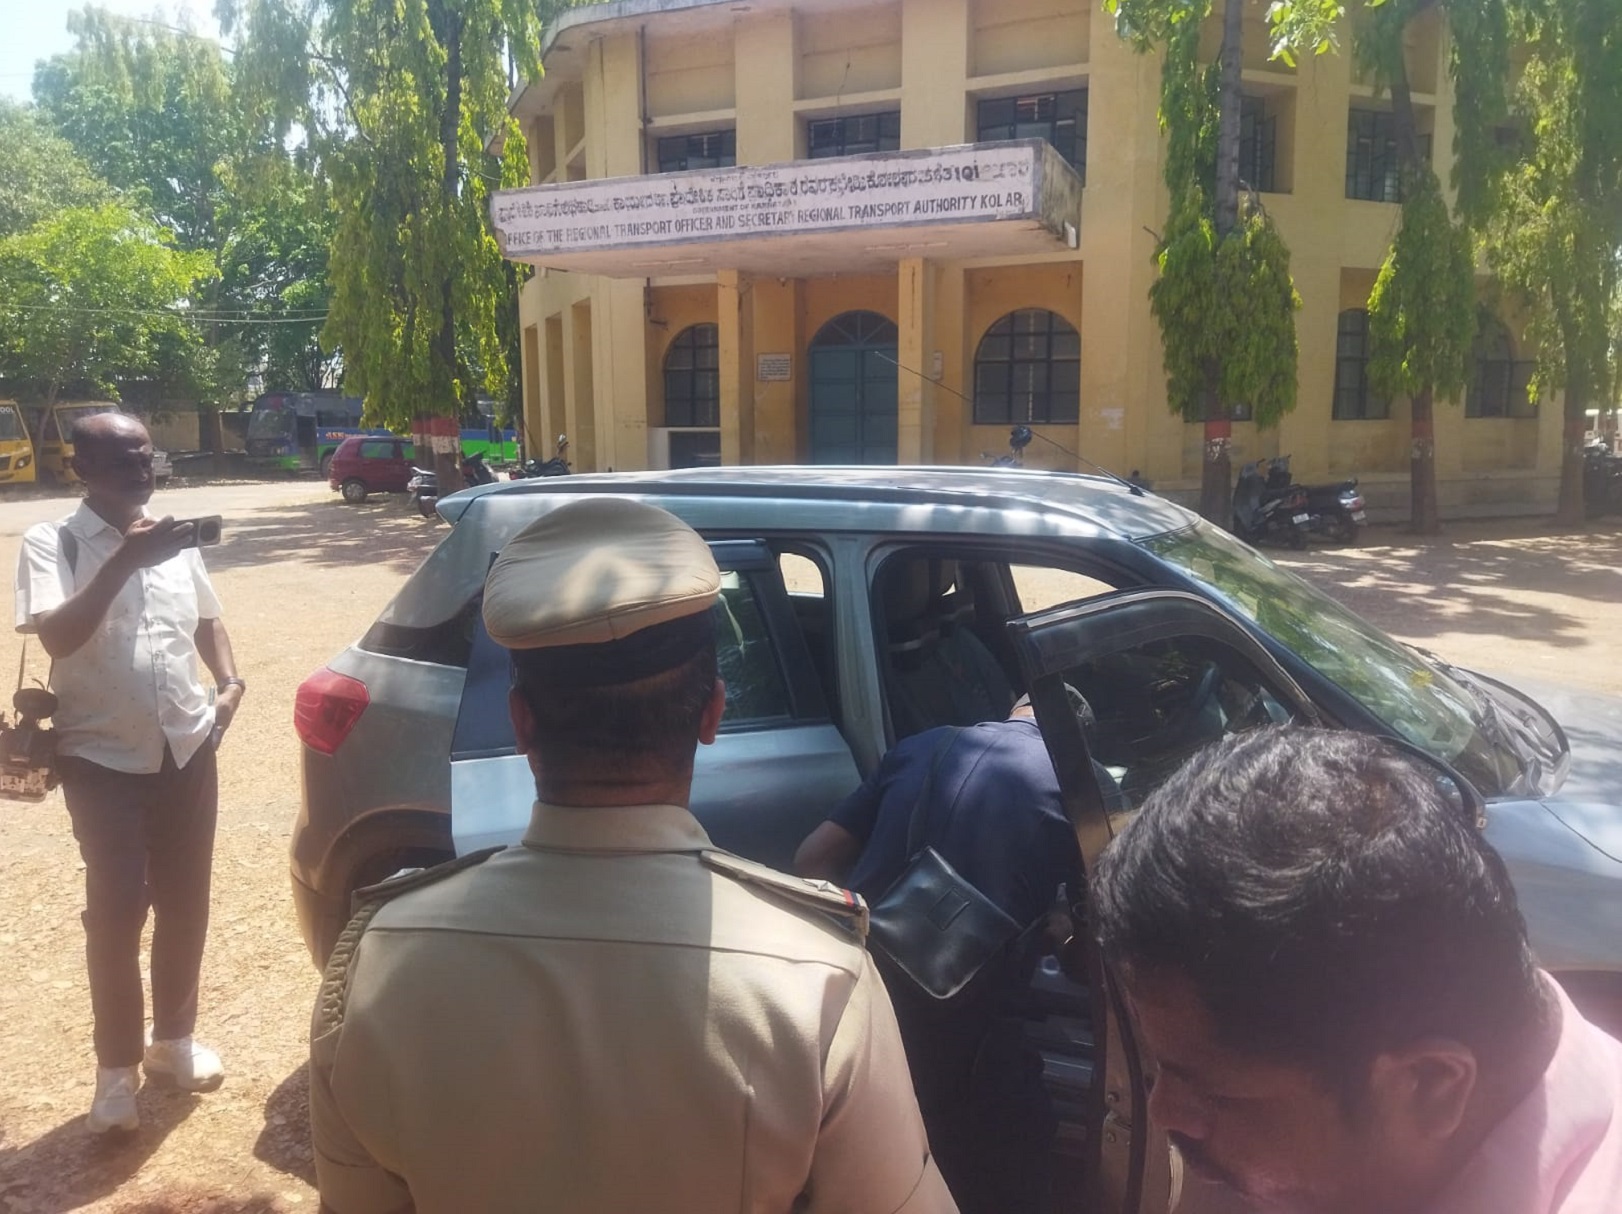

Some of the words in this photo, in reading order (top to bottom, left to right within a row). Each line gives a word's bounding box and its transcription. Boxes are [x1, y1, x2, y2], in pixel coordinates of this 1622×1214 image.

[506, 230, 531, 246] FFICE
[546, 228, 564, 242] THE
[566, 224, 611, 242] REGIONAL
[614, 220, 672, 237] TRANSPORT
[675, 216, 713, 234] OFFICER
[715, 214, 735, 230] AND
[738, 209, 795, 228] SECRETARY
[797, 205, 846, 224] REGIONAL
[848, 200, 911, 220] TRANSPORT
[913, 194, 977, 214] AUTHORITY
